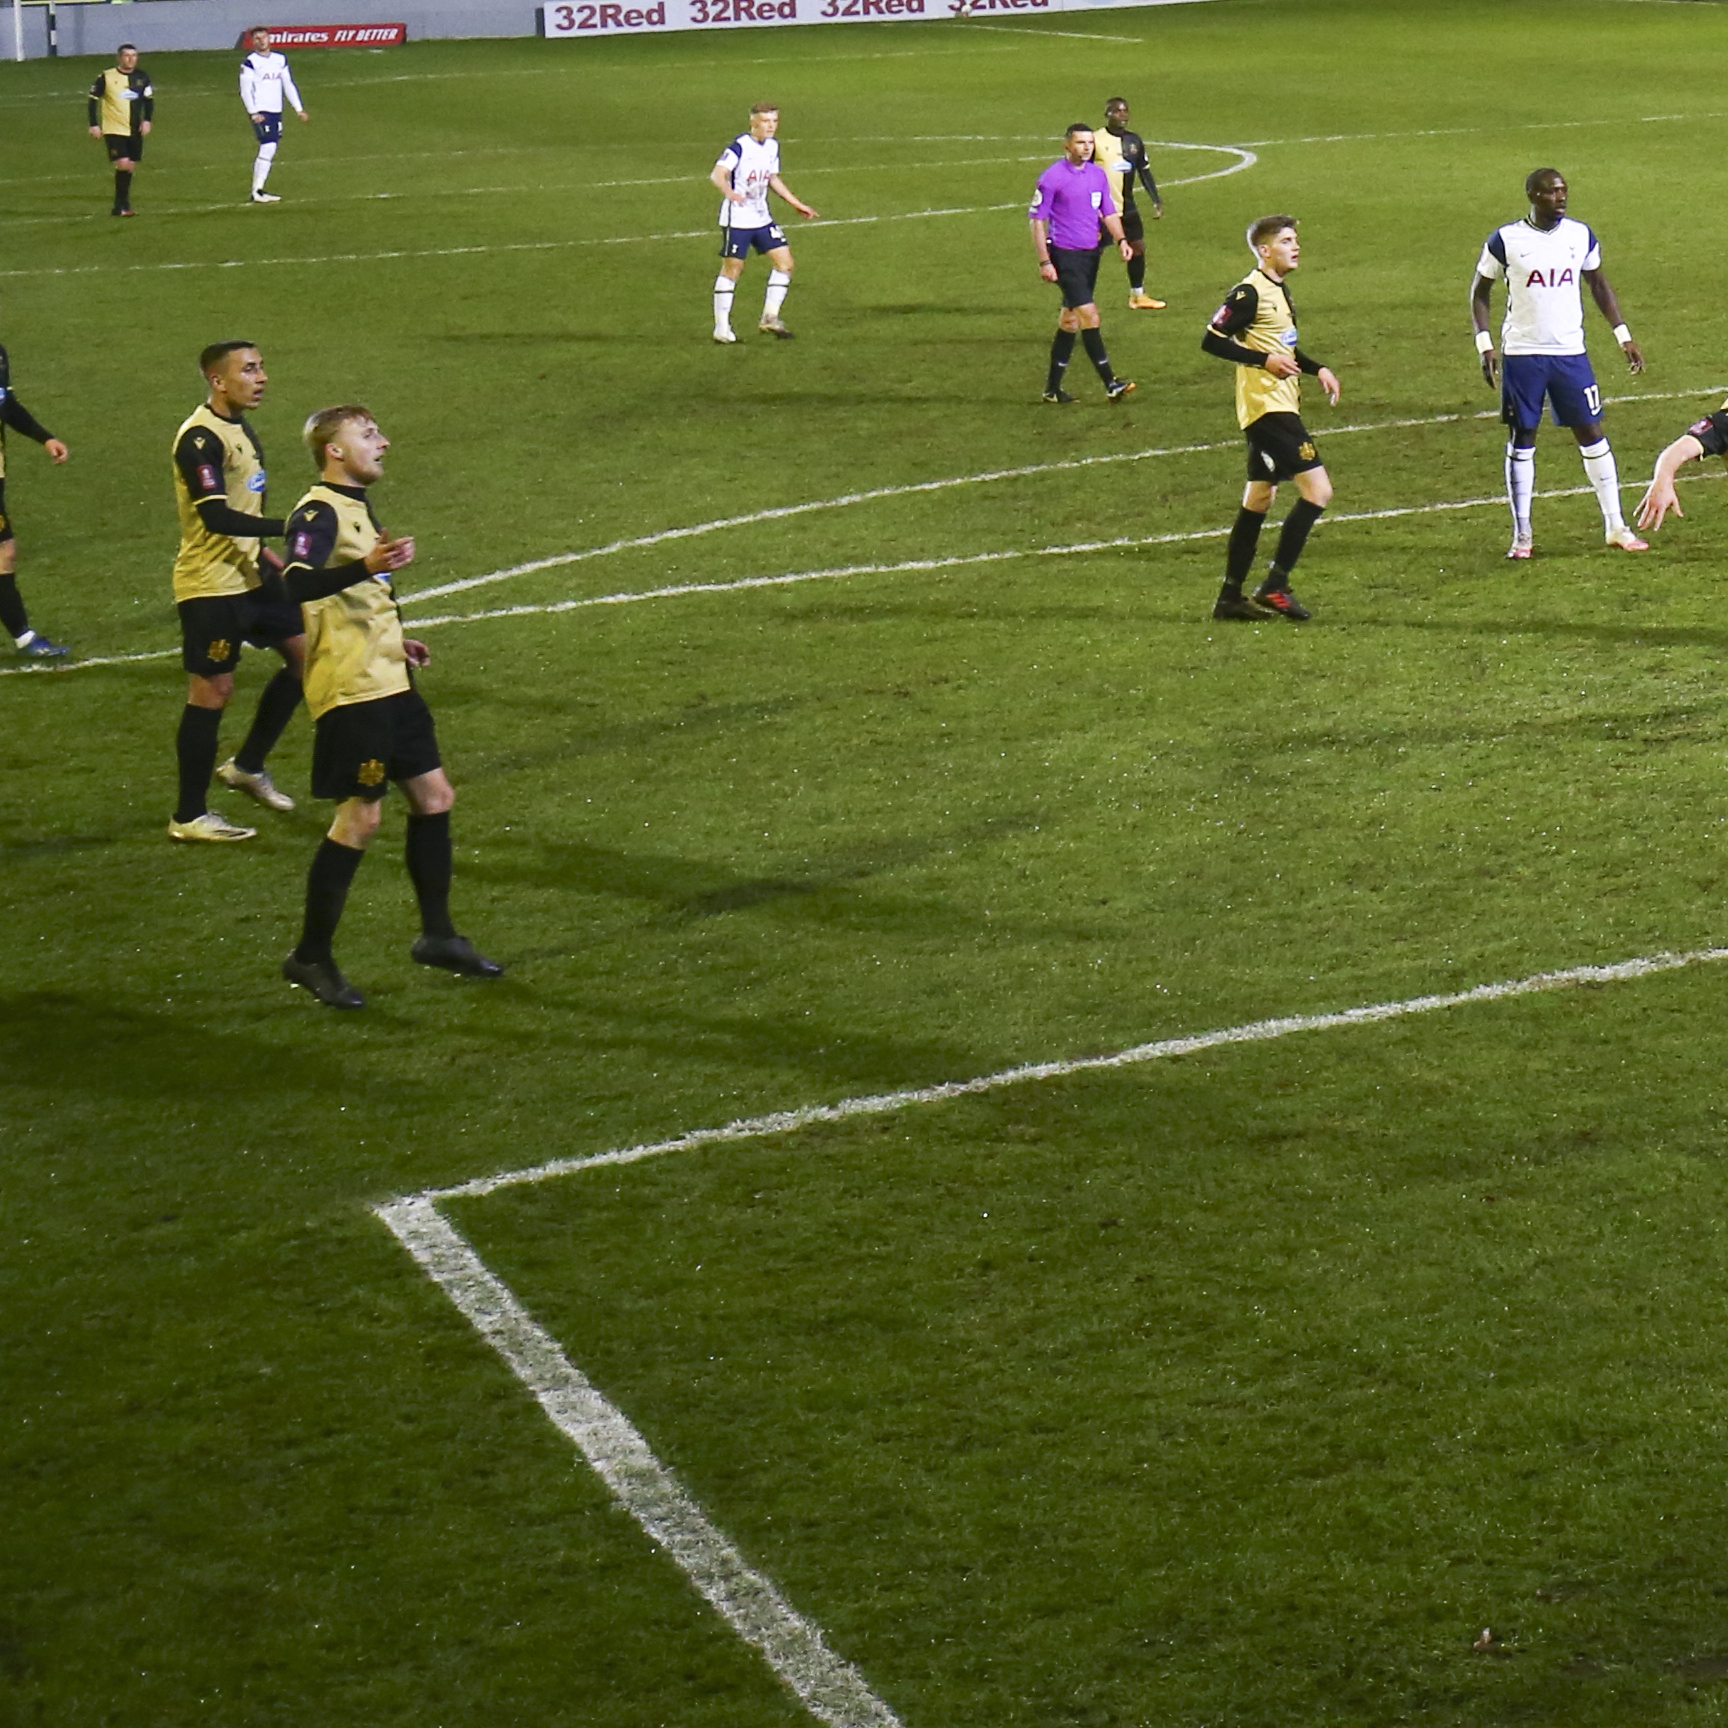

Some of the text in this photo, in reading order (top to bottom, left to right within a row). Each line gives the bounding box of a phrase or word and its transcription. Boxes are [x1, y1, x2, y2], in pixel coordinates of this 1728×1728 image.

[555, 1, 666, 31] 32Red
[269, 28, 399, 44] mirates FLY BETTER
[1525, 267, 1575, 288] AIA
[1583, 384, 1600, 410] 17
